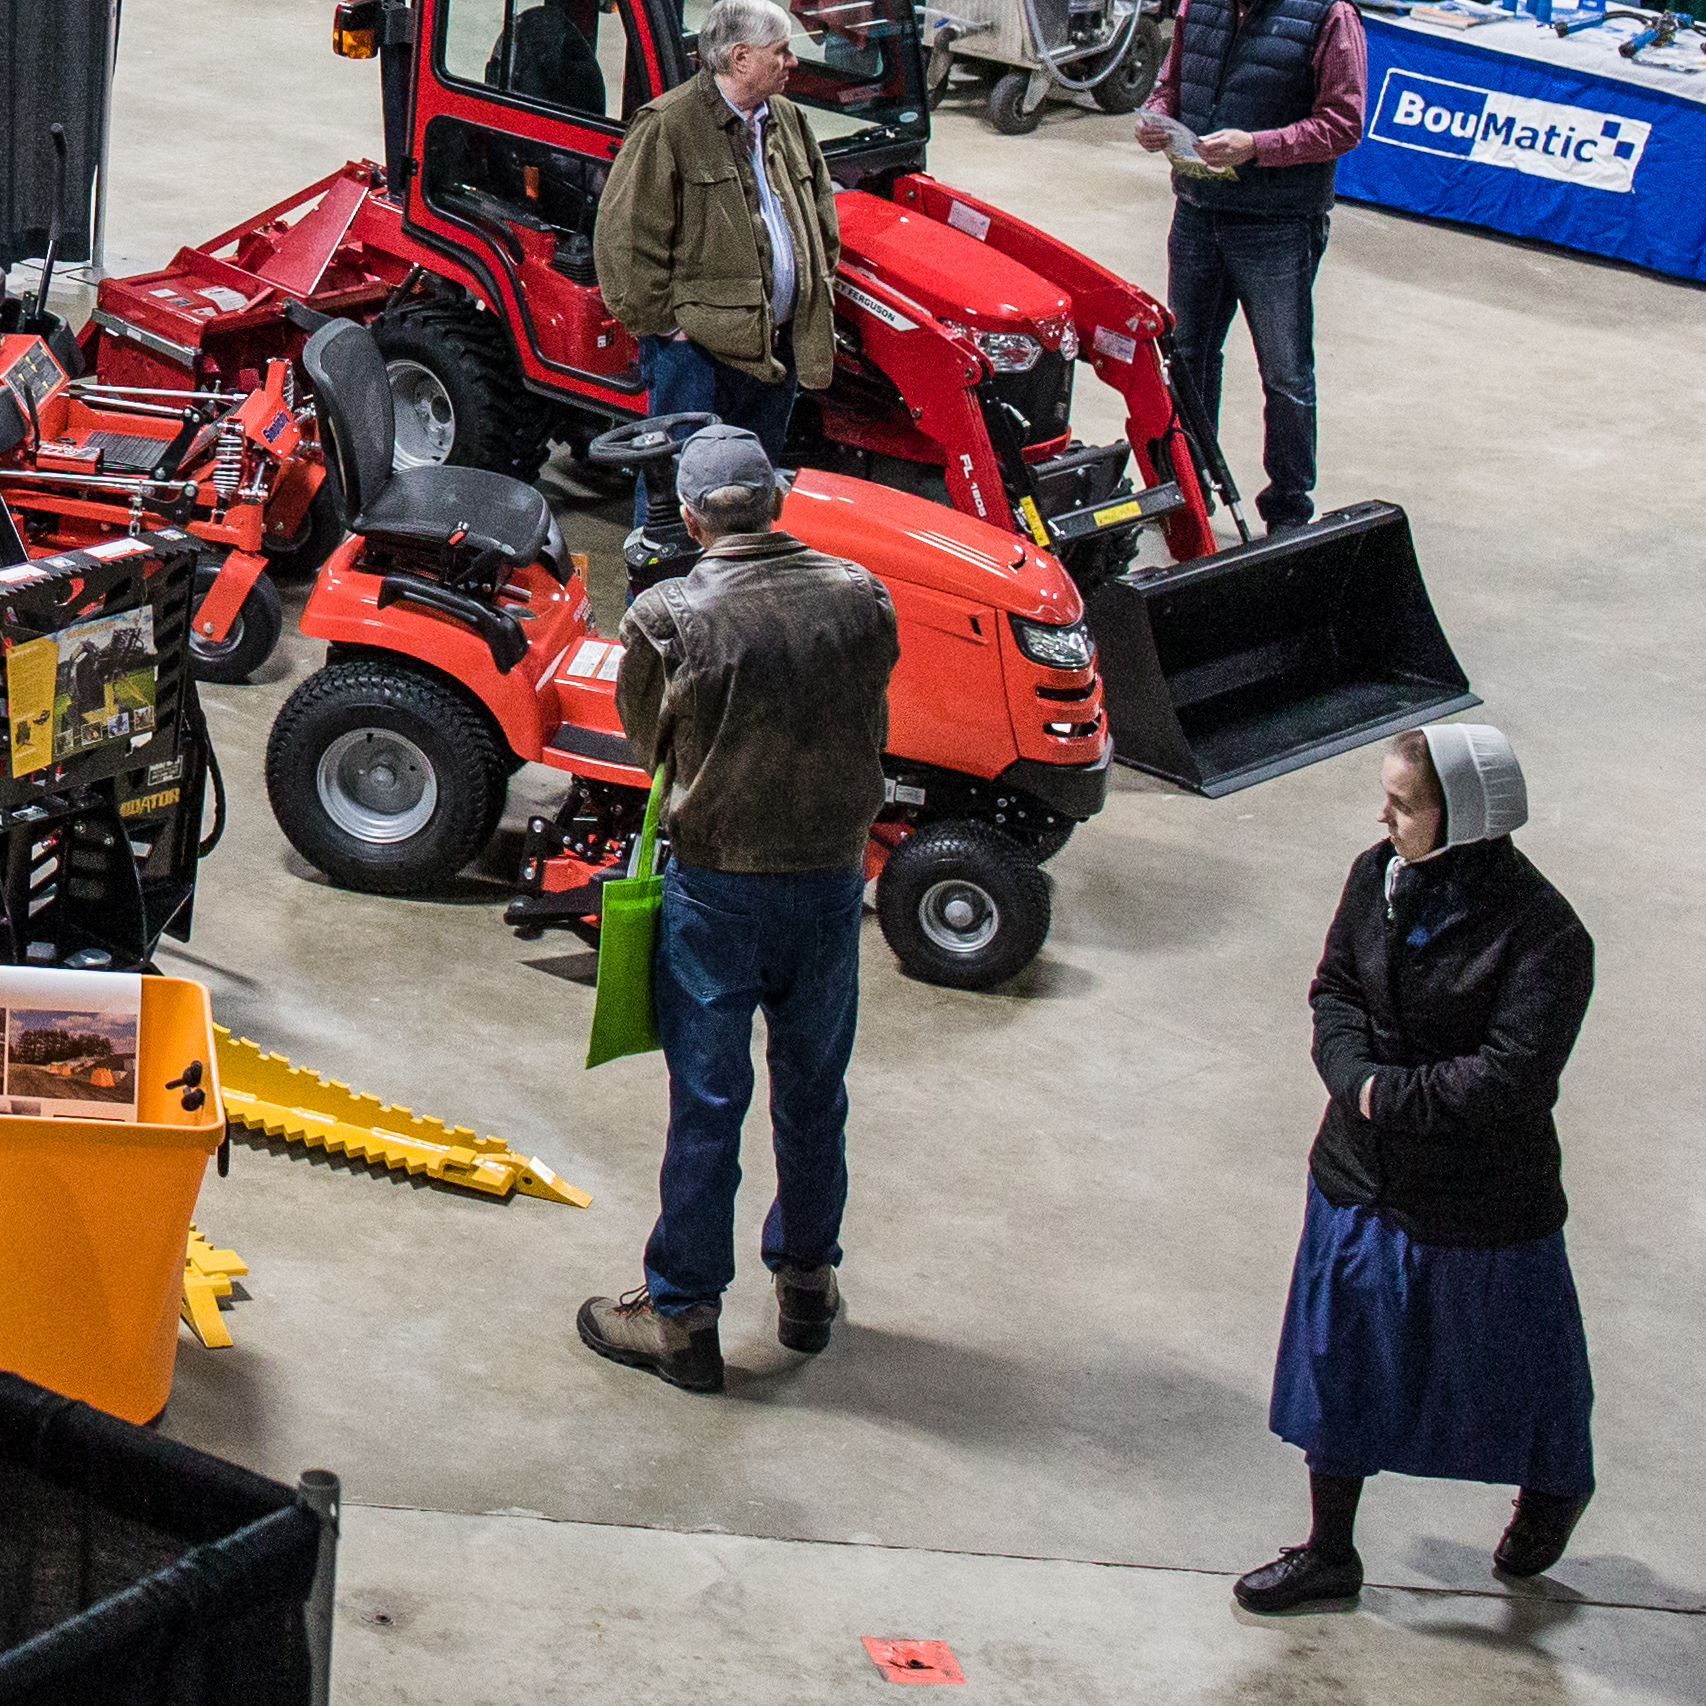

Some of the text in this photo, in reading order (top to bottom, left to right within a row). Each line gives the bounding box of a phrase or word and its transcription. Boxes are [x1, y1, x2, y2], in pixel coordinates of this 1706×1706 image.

[1393, 90, 1598, 163] BouMatic
[847, 287, 897, 324] FERGUSON
[959, 453, 978, 479] FL
